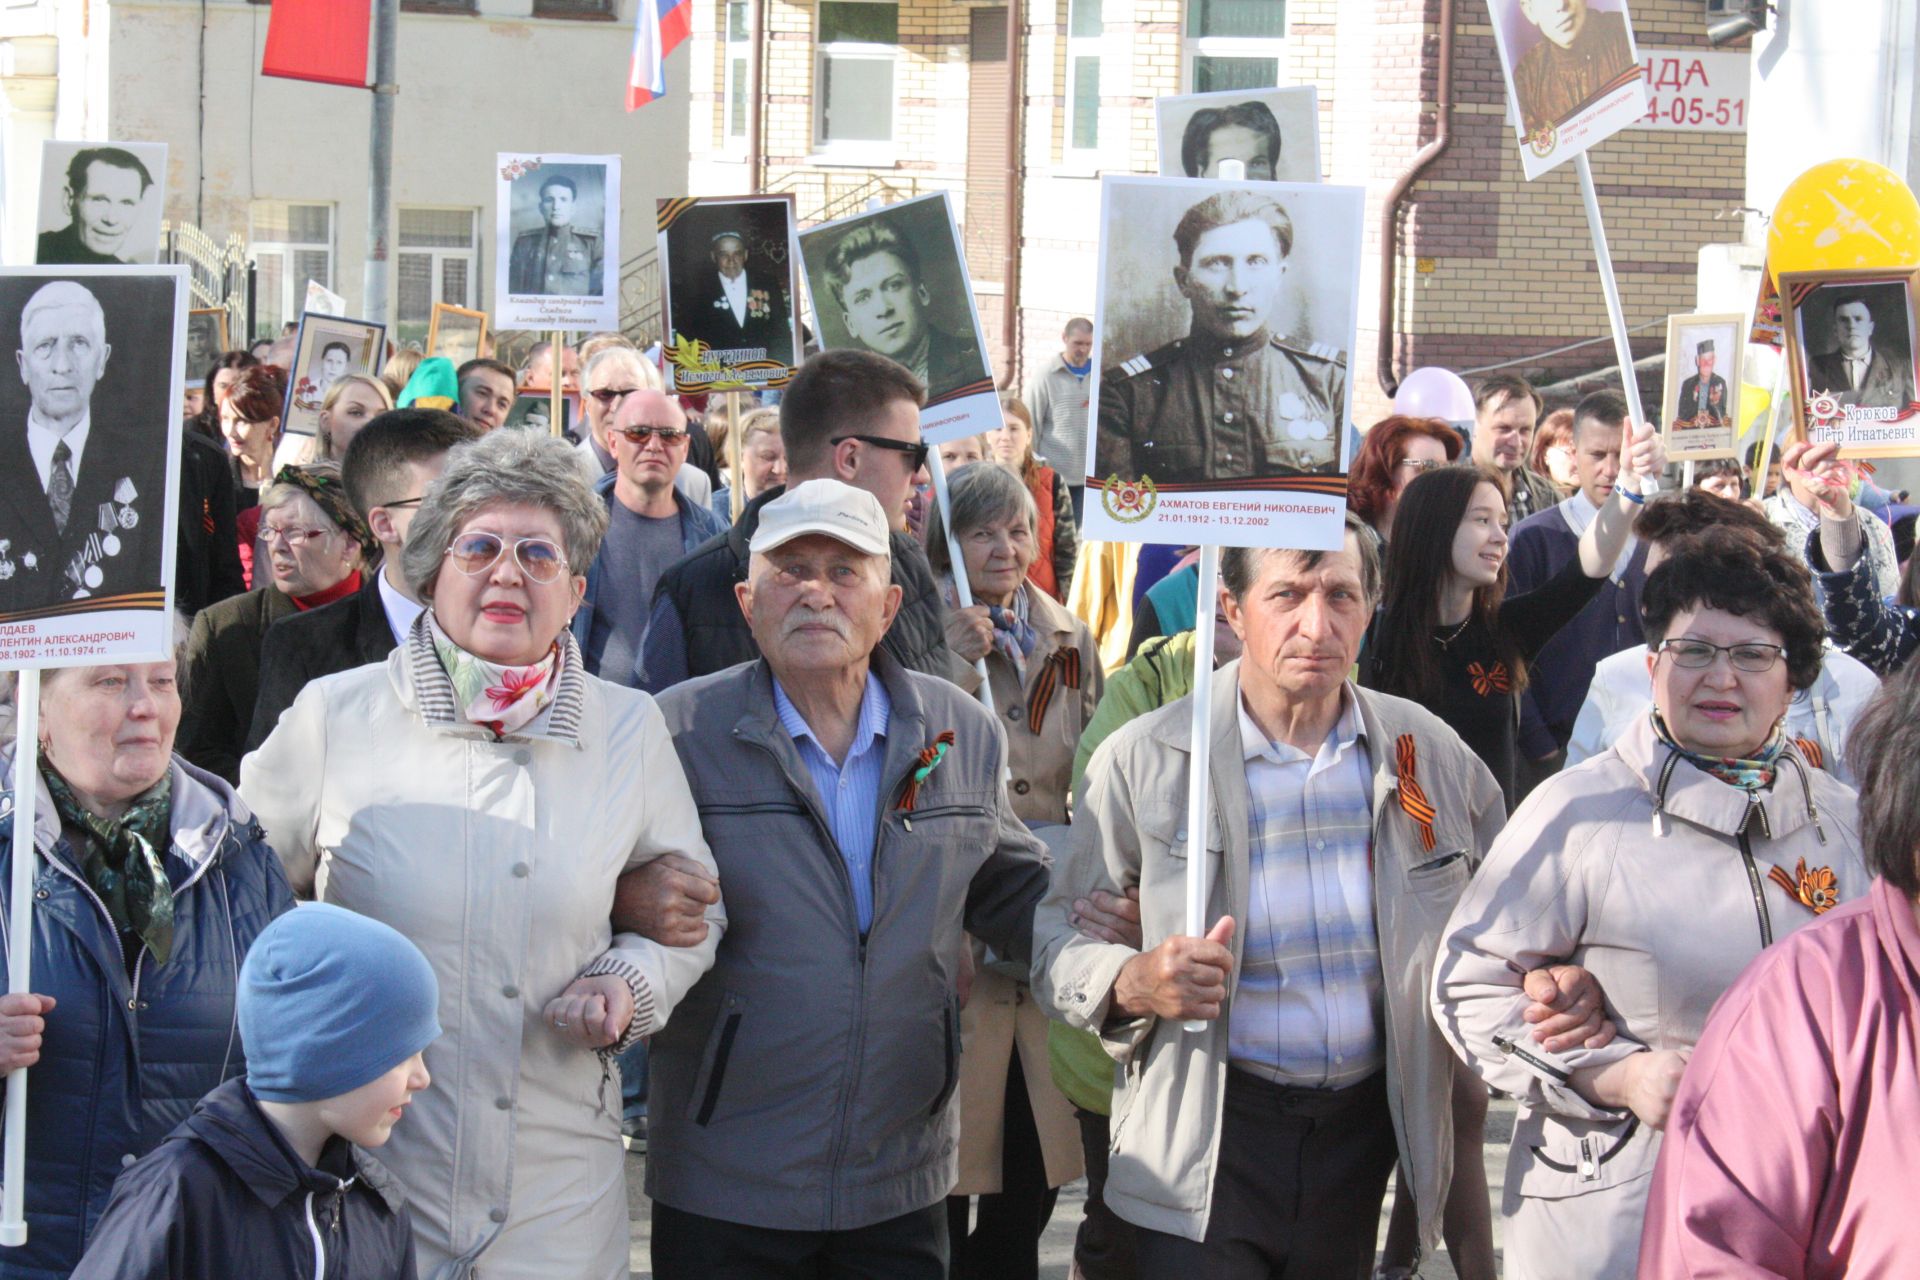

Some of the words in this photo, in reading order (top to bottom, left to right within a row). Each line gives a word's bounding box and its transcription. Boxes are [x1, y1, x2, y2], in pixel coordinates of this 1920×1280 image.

[1634, 96, 1745, 126] 4-05-51
[1845, 404, 1898, 424] Крюков
[1816, 426, 1845, 446] Пётр
[1847, 425, 1916, 442] Игнатьевич
[1159, 500, 1210, 510] АХМАТОВ
[1212, 501, 1262, 513] ЕВГЕНИЙ
[1264, 504, 1336, 515] НИКОЛАЕВИЧ
[1158, 514, 1210, 524] 21.01.1912
[1218, 516, 1270, 527] 13.12.2002
[0, 624, 36, 636] ЛДАЕВ
[0, 636, 42, 648] ЛЕНТИН
[44, 631, 136, 646] АЛЕКСАНДРОВИЧ
[44, 646, 95, 658] 11.10.1974
